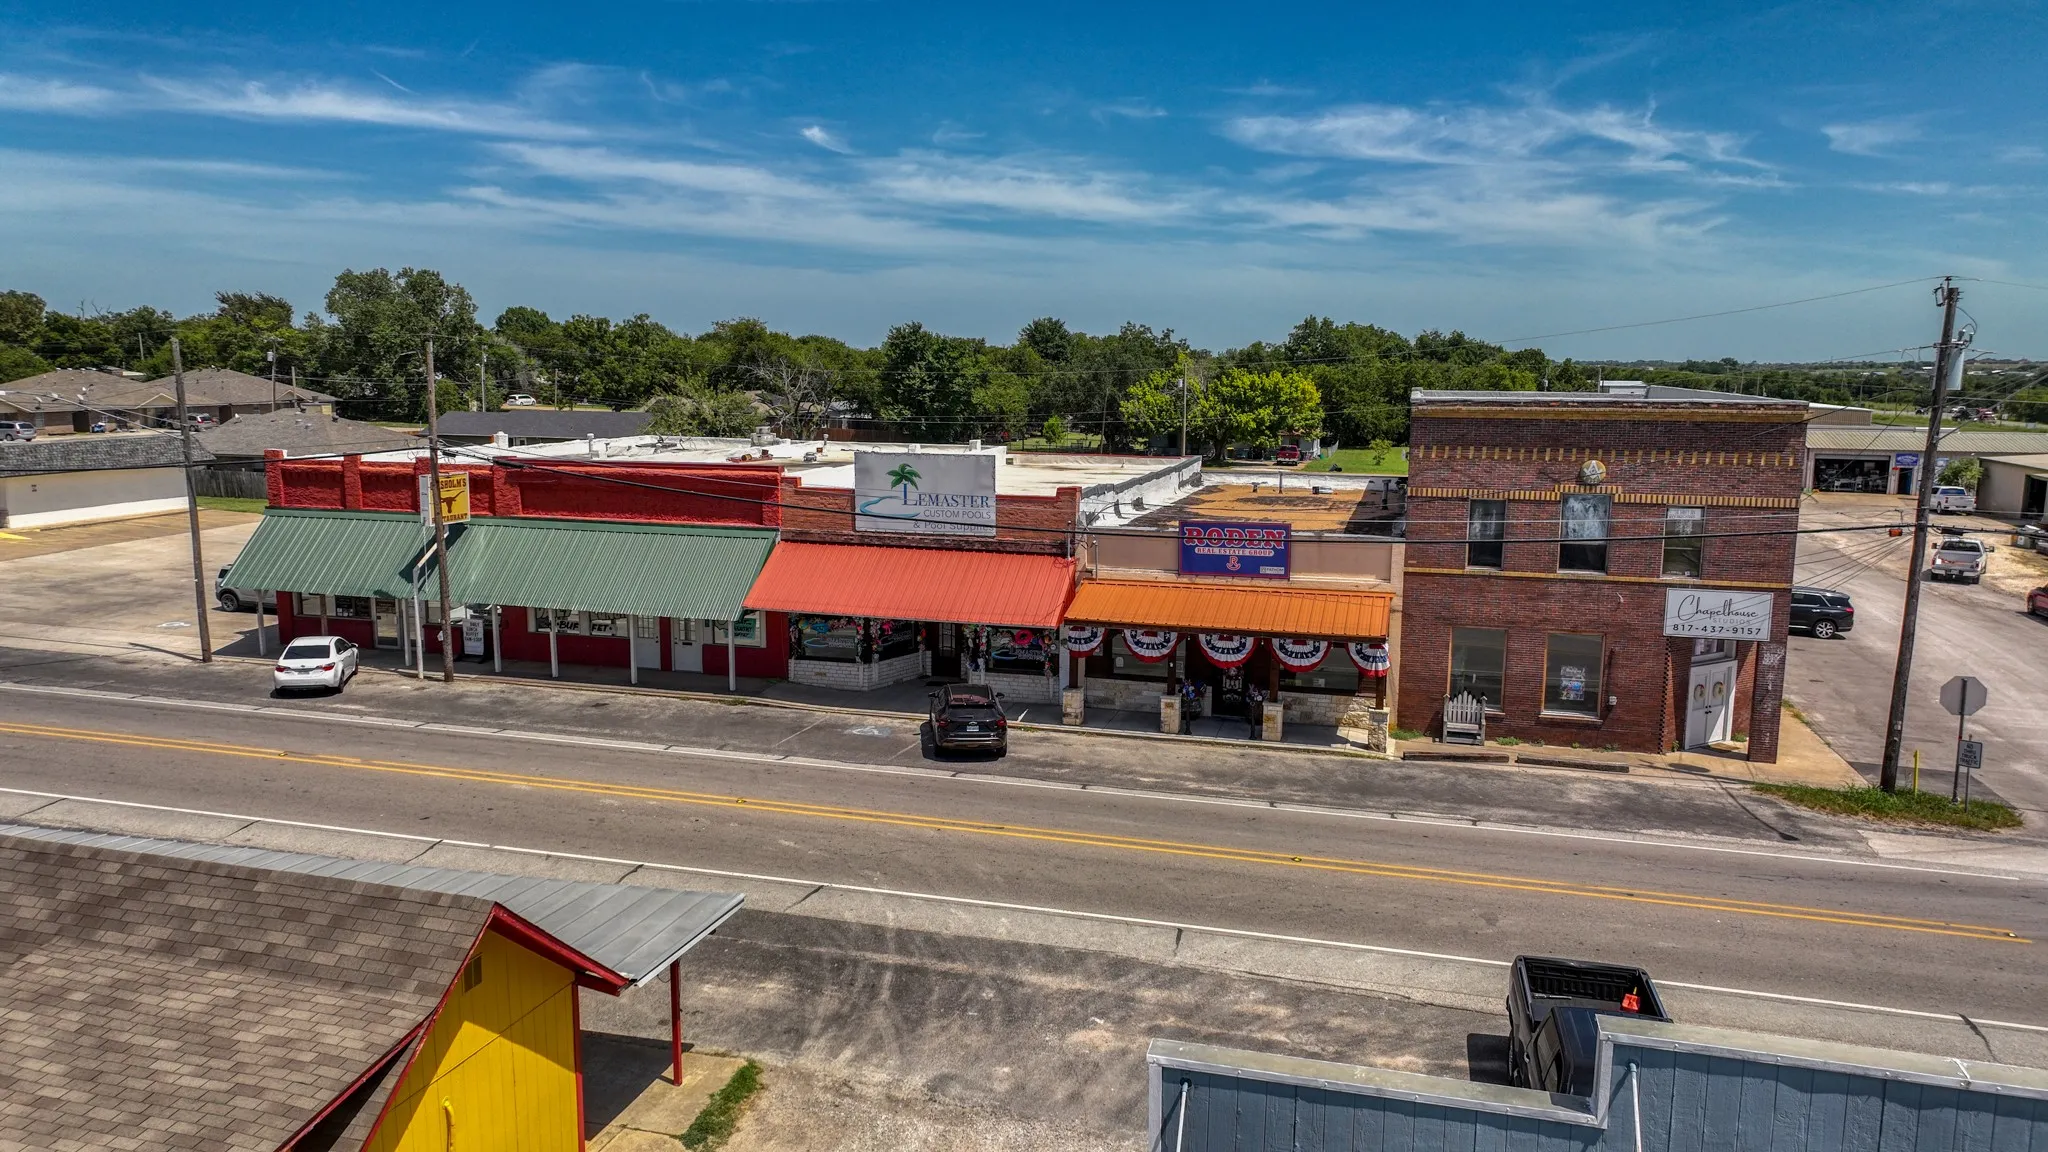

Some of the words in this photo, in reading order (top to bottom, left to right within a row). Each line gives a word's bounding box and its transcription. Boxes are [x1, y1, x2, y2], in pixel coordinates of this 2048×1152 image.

[440, 478, 467, 489] SHOLM'S
[902, 483, 990, 508] LEMASTER
[924, 509, 960, 519] CUSTOM
[962, 510, 992, 520] POOLS
[913, 521, 920, 529] &
[924, 521, 946, 530] Pool
[1184, 527, 1285, 549] RODEN
[1677, 594, 1758, 621] Chapelhouse
[1672, 624, 1762, 635] 817-437-9157
